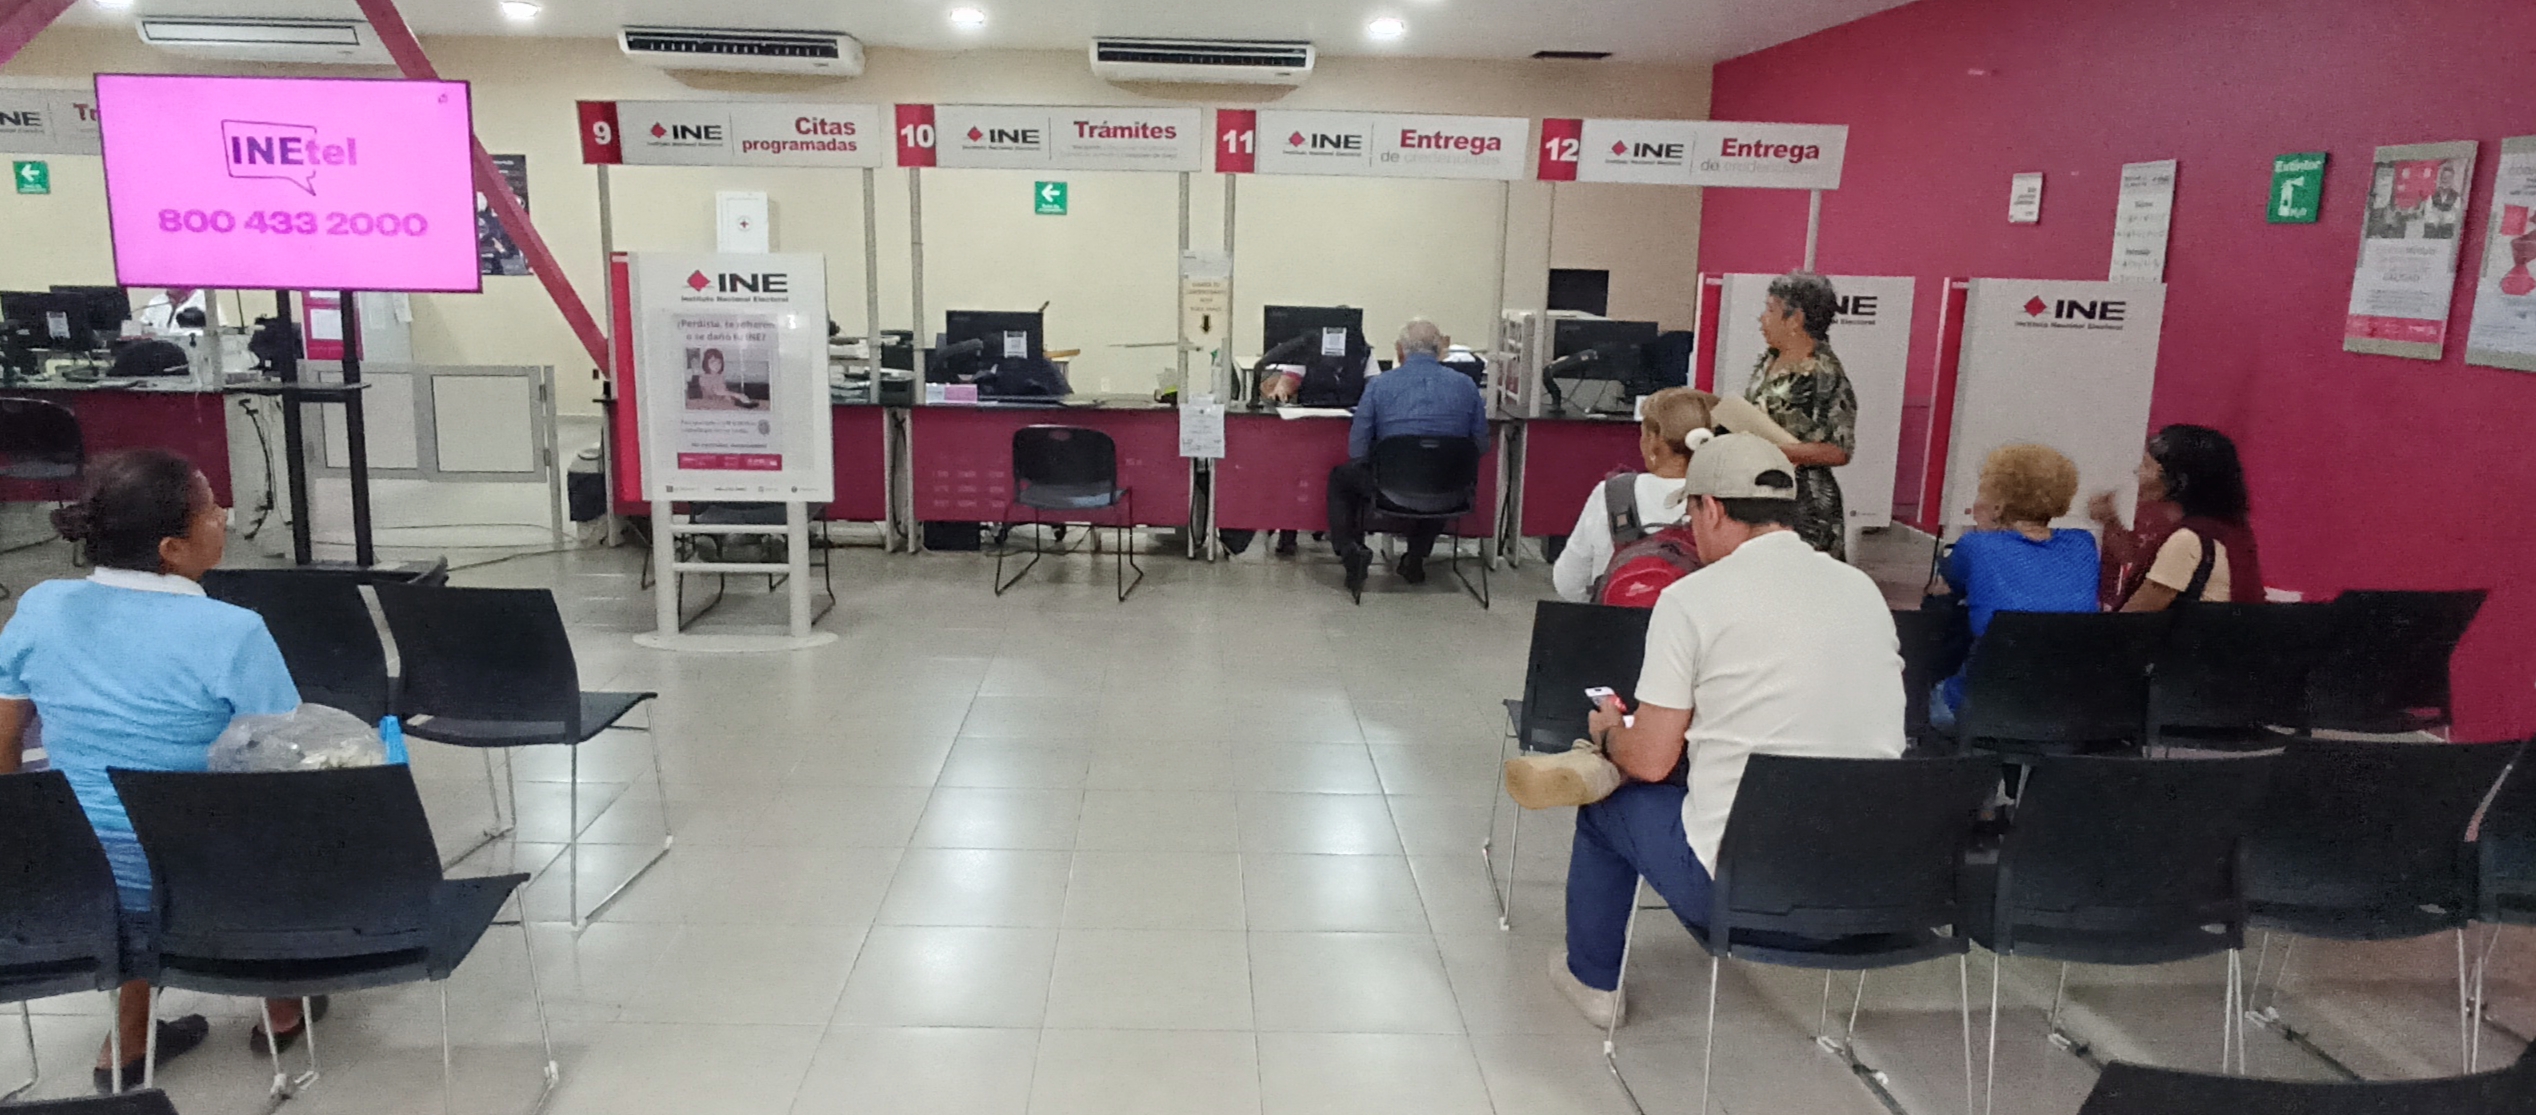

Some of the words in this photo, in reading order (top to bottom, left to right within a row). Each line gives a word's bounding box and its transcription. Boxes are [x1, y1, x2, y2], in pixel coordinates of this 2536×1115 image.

[0, 111, 42, 126] NE
[795, 116, 856, 136] Citas
[592, 121, 612, 145] 9
[672, 125, 722, 140] INE
[901, 124, 935, 148] 10
[989, 129, 1040, 144] INE
[1073, 120, 1177, 140] Trámites
[231, 135, 358, 166] INEtel
[742, 138, 857, 154] programadas
[1222, 130, 1254, 154] 11
[1311, 133, 1363, 149] INE
[1400, 128, 1502, 155] Entrega
[1545, 137, 1579, 161] 12
[1633, 142, 1684, 159] INE
[1720, 137, 1820, 164] Entrega
[1380, 150, 1400, 162] de
[158, 208, 236, 233] 800
[244, 210, 318, 235] 433
[326, 211, 428, 237] 2000
[718, 273, 788, 293] INE
[1831, 295, 1878, 316] NE
[2054, 300, 2126, 320] INE
